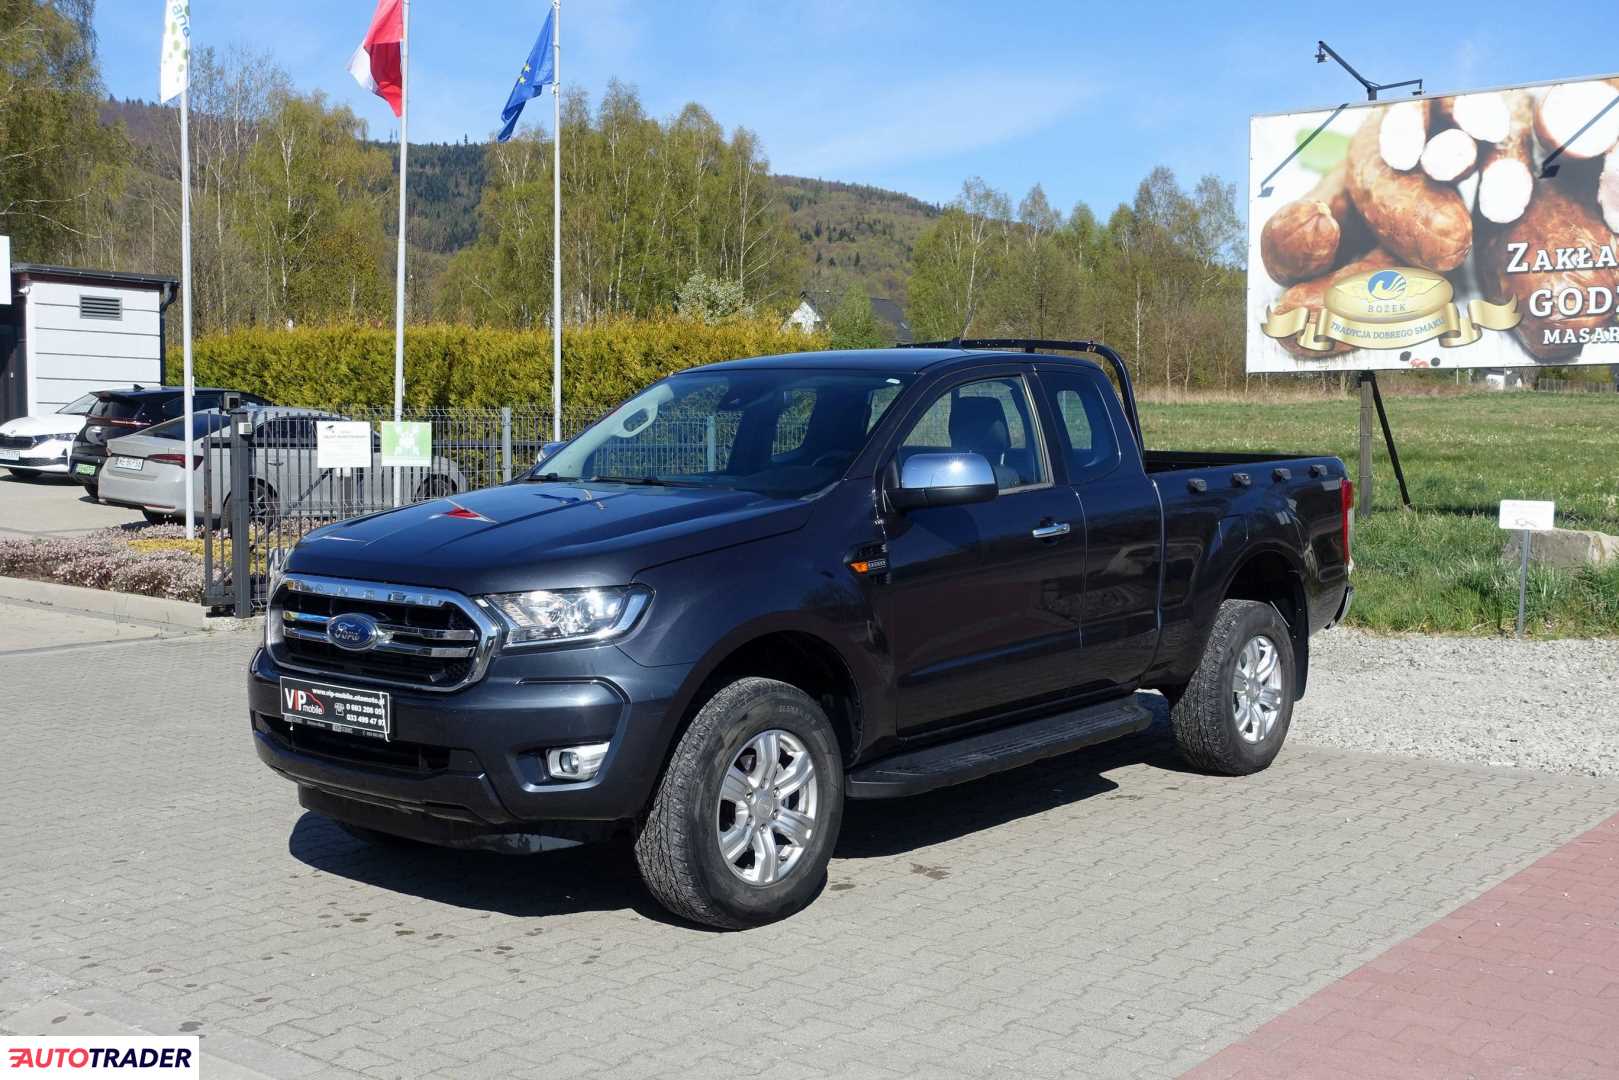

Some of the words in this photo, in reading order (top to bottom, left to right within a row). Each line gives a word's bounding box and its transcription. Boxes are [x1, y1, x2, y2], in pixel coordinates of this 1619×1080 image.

[1529, 286, 1619, 317] GOD
[1330, 320, 1371, 339] TRADYCJA
[1373, 328, 1413, 339] DOBREGO
[1543, 326, 1619, 344] MASAR
[335, 622, 360, 641] Ford
[285, 688, 306, 711] VIP
[303, 704, 324, 715] mobile
